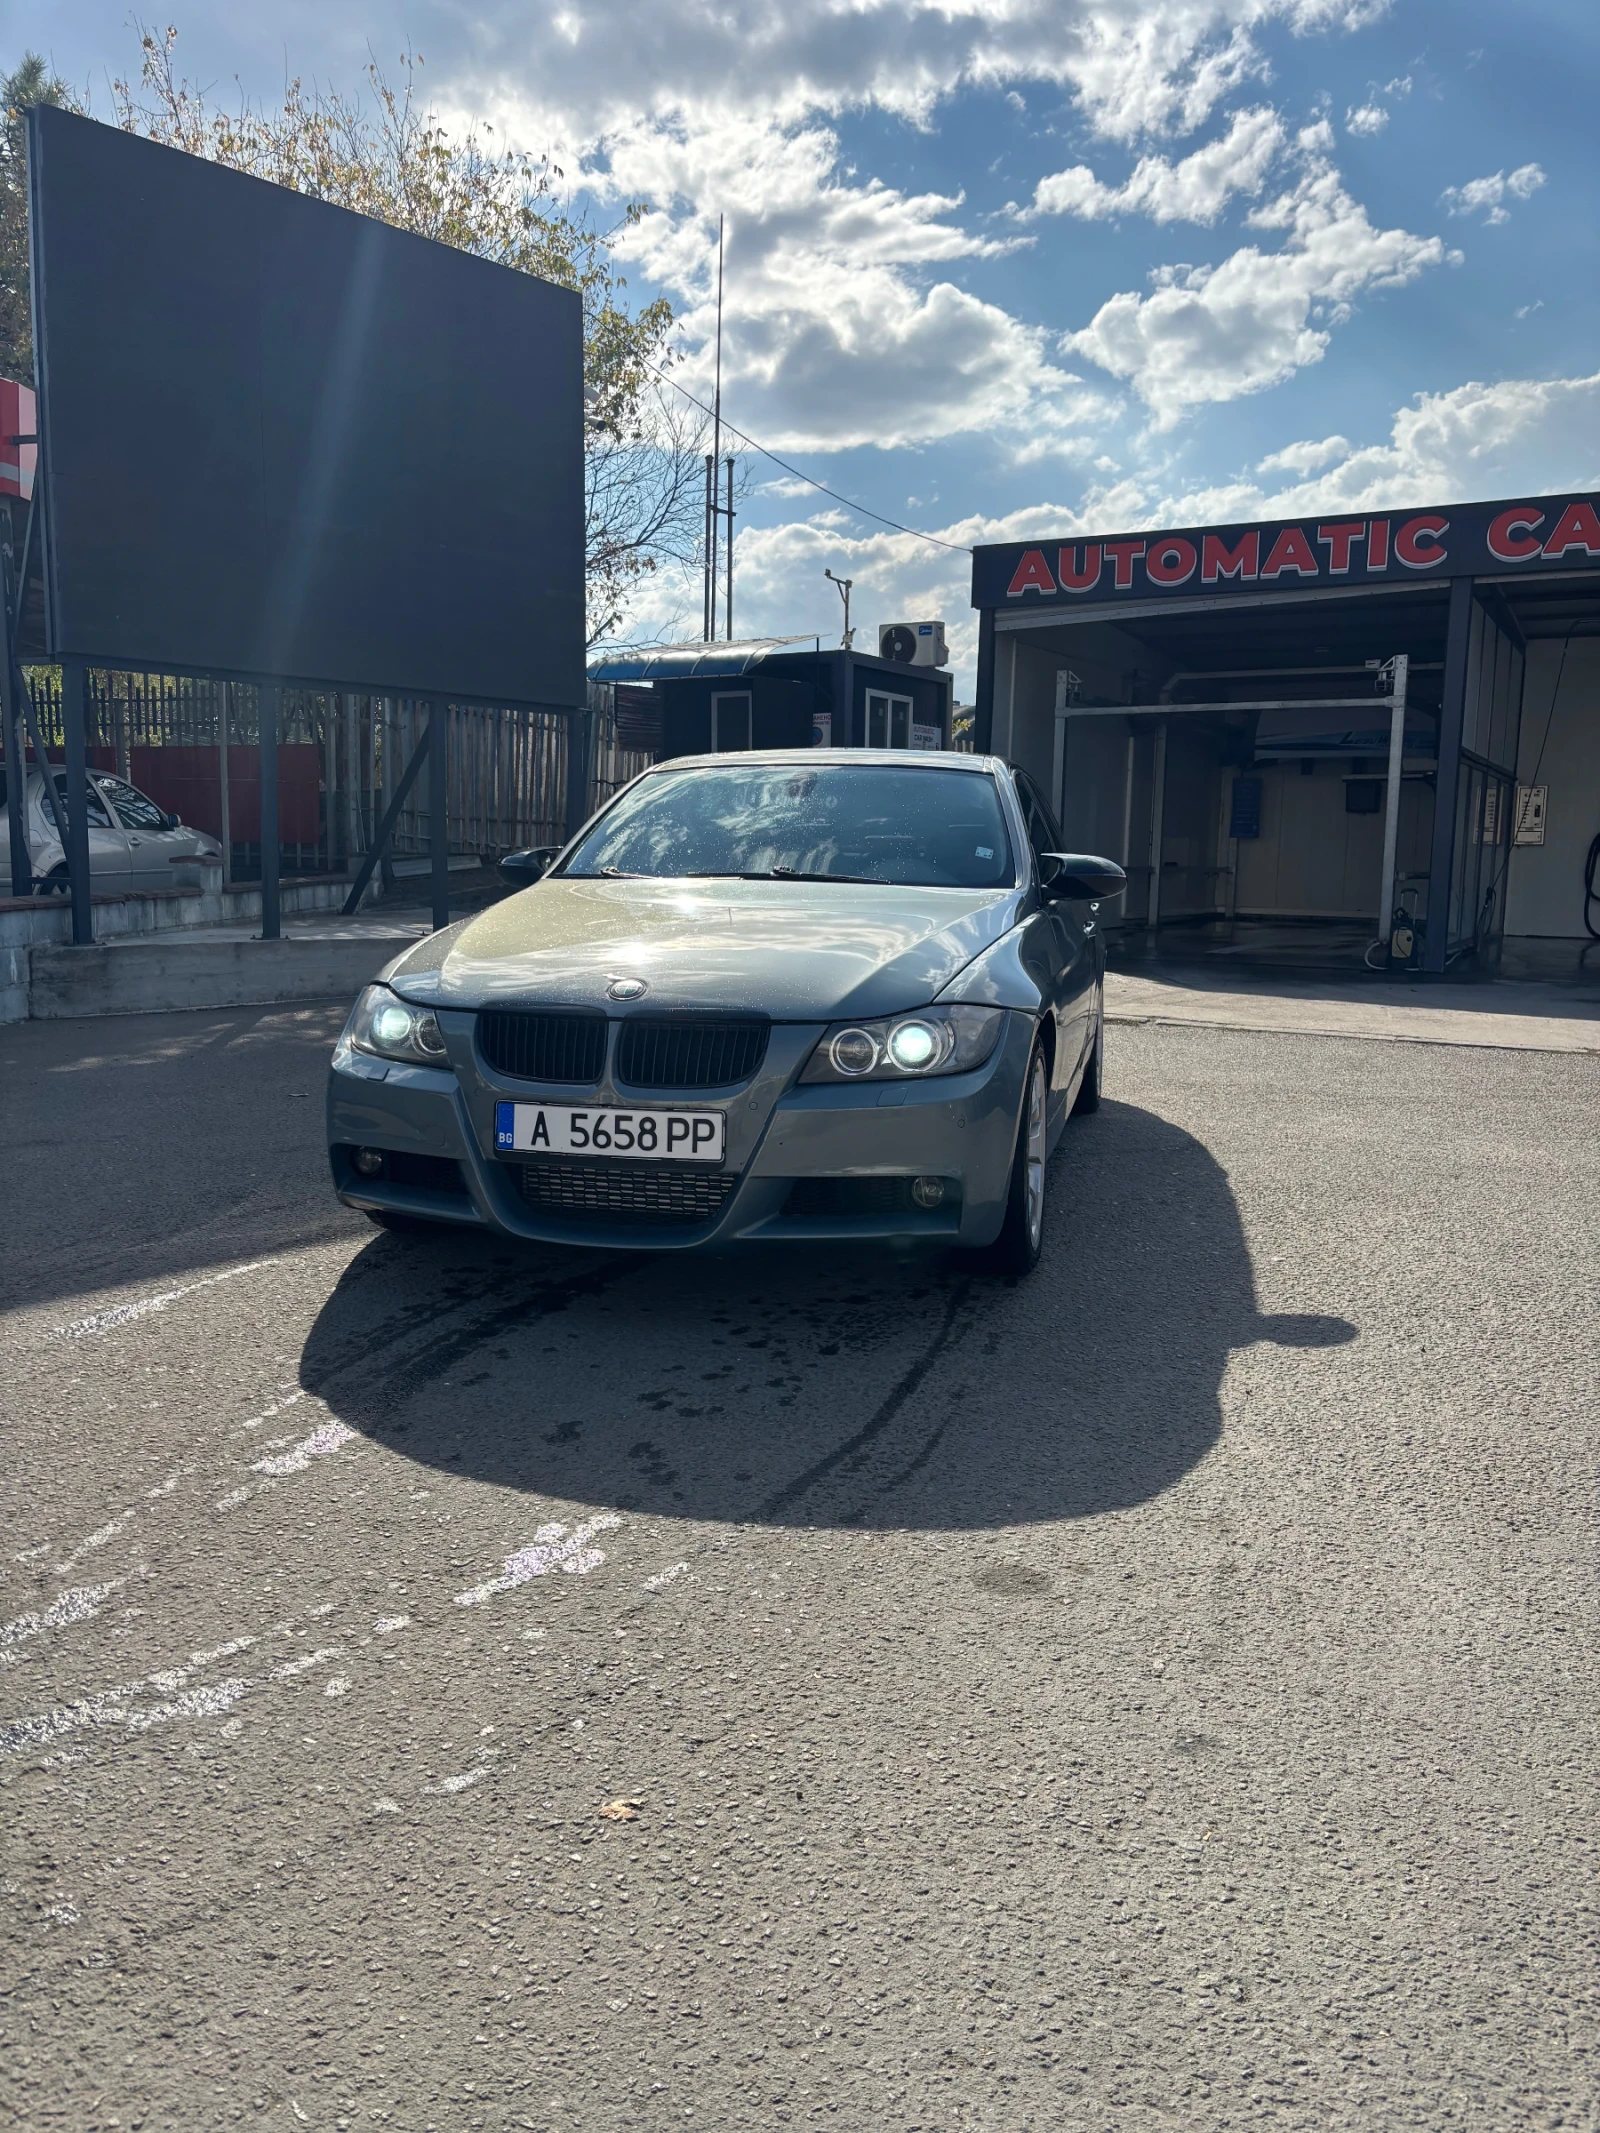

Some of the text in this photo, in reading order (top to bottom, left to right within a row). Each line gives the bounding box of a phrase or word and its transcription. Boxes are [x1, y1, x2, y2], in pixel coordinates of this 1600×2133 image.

[1006, 515, 1449, 598] AUTOMATIC
[913, 726, 935, 735] AUTOMATIC
[914, 734, 922, 742] CAR
[498, 1132, 513, 1144] BG
[530, 1111, 716, 1153] A 5658 PP
